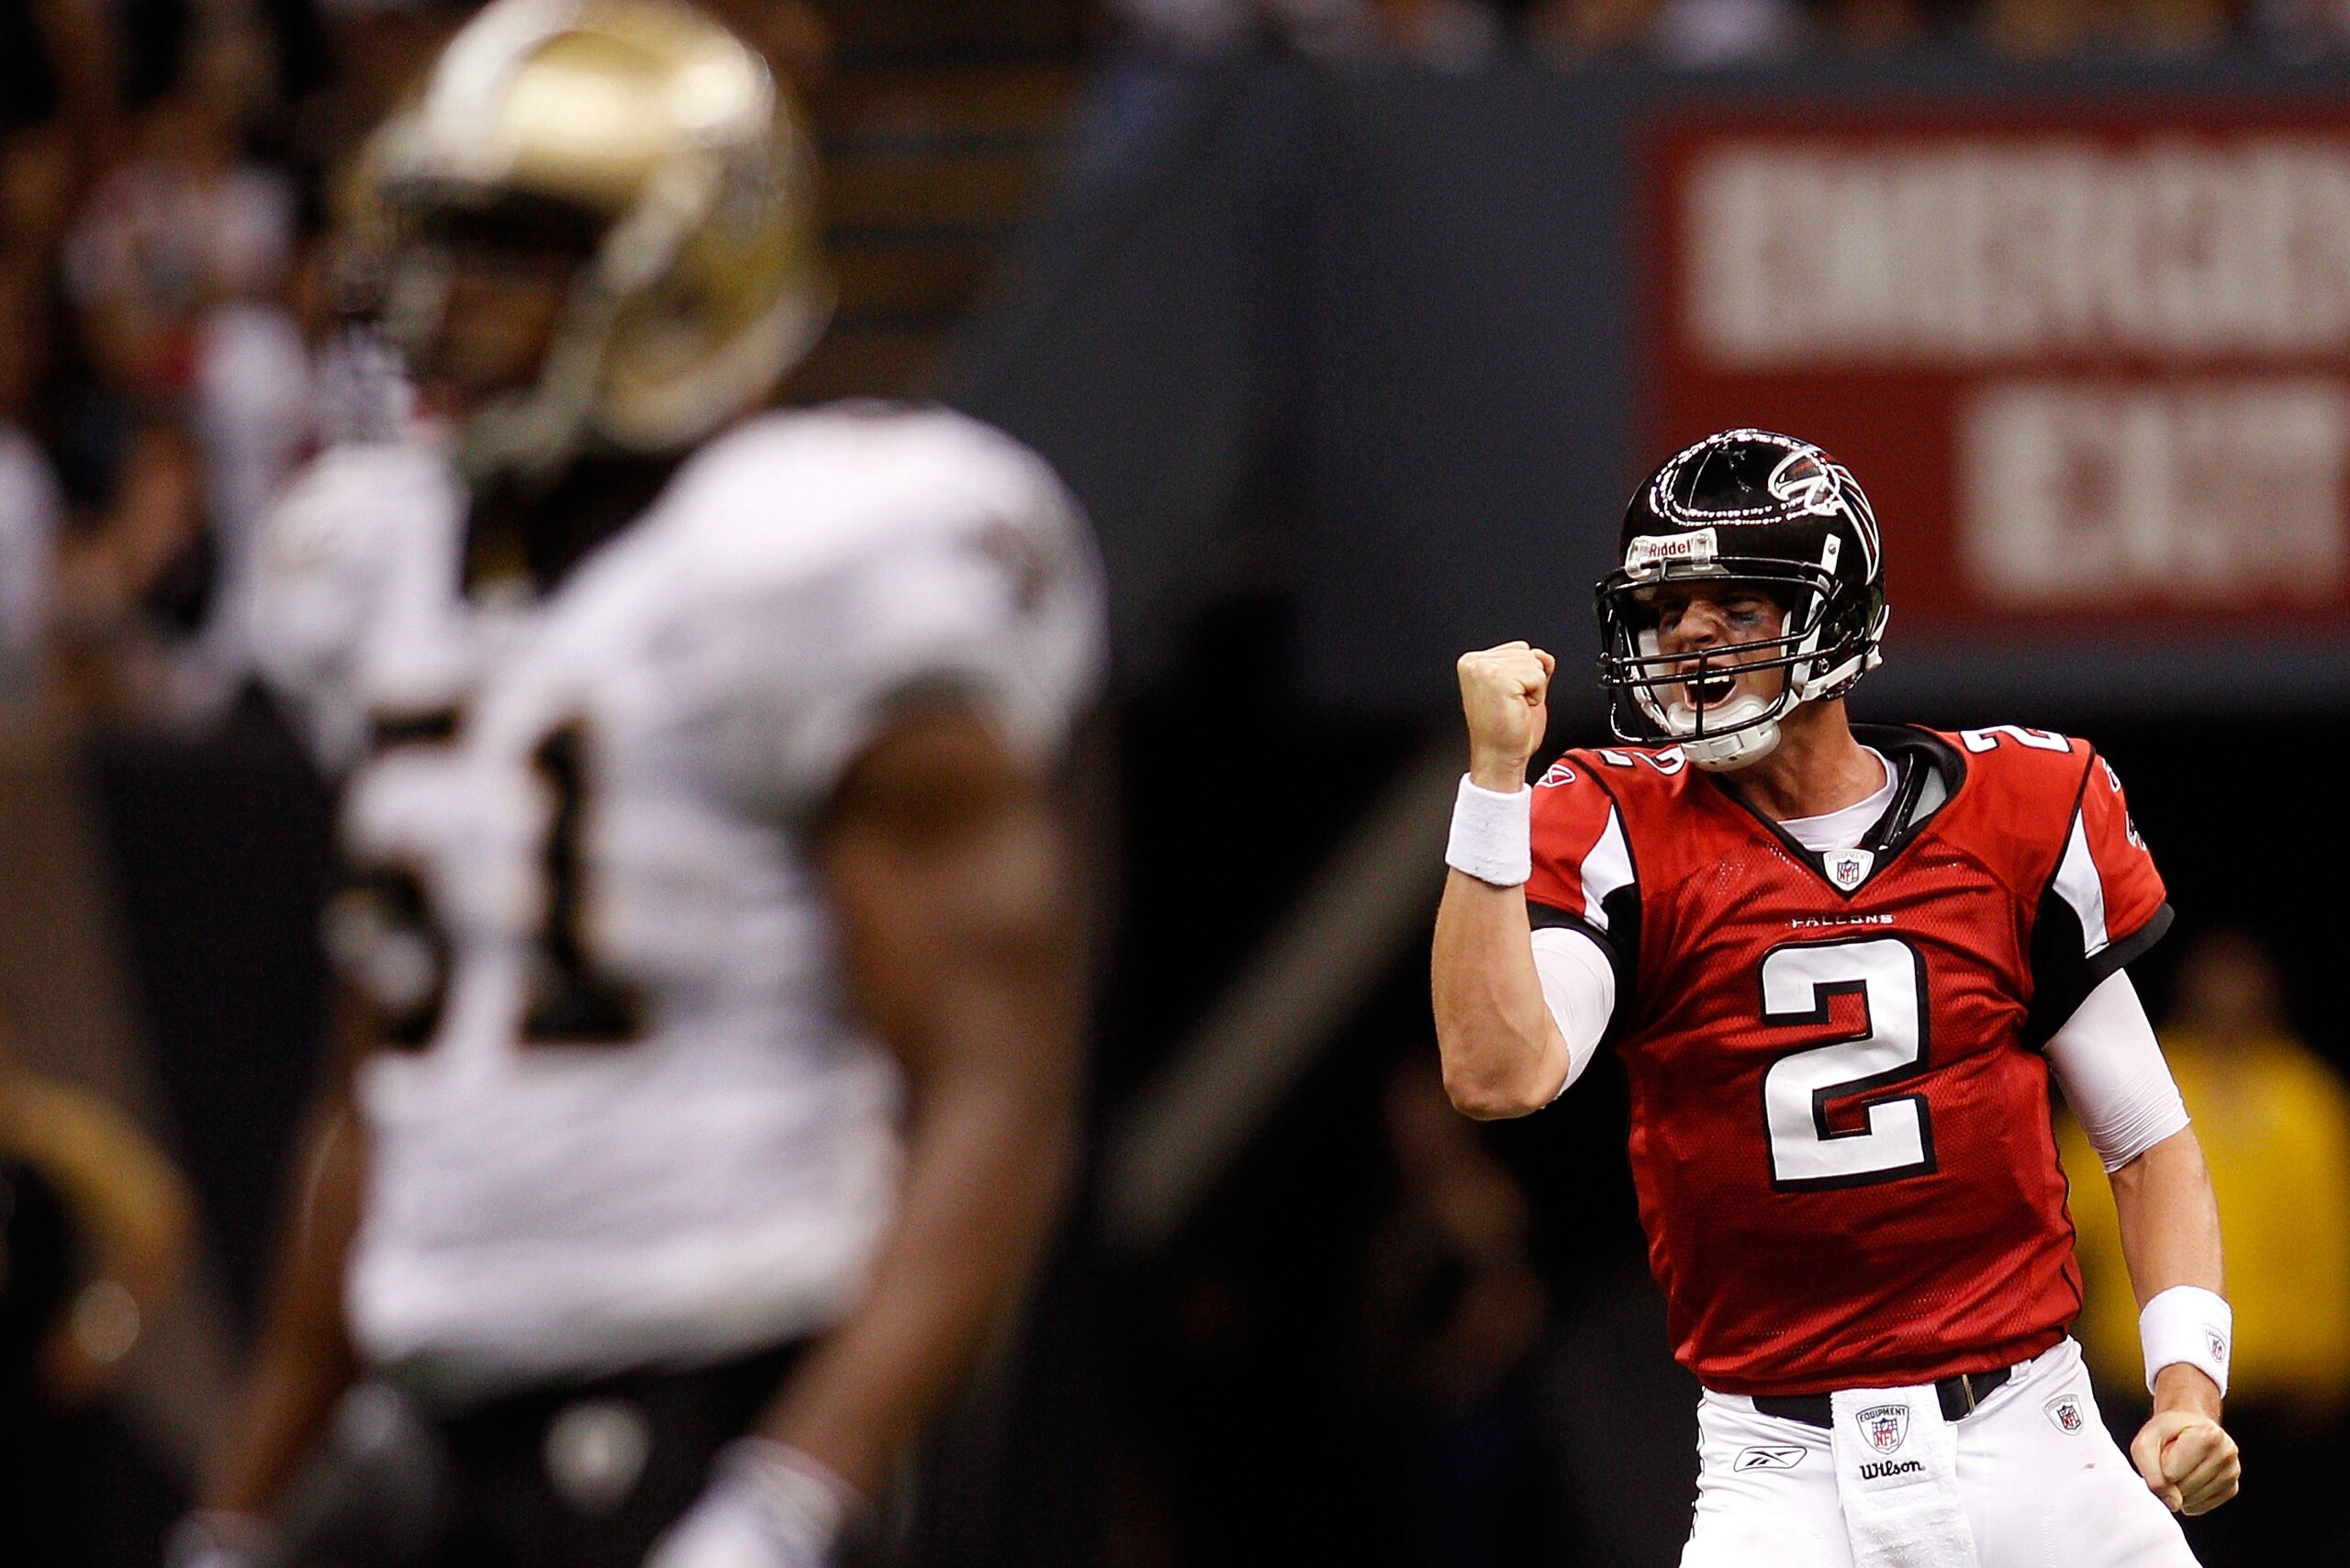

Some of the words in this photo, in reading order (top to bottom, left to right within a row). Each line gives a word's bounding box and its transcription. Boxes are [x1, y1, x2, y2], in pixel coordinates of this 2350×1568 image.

[336, 705, 647, 1052] 51
[1791, 914, 1895, 928] FALCONS
[1760, 936, 1933, 1188] 2
[1860, 1406, 1906, 1422] EQUIPMENT
[1875, 1430, 1897, 1447] NFL
[1859, 1460, 1922, 1480] Wilson
